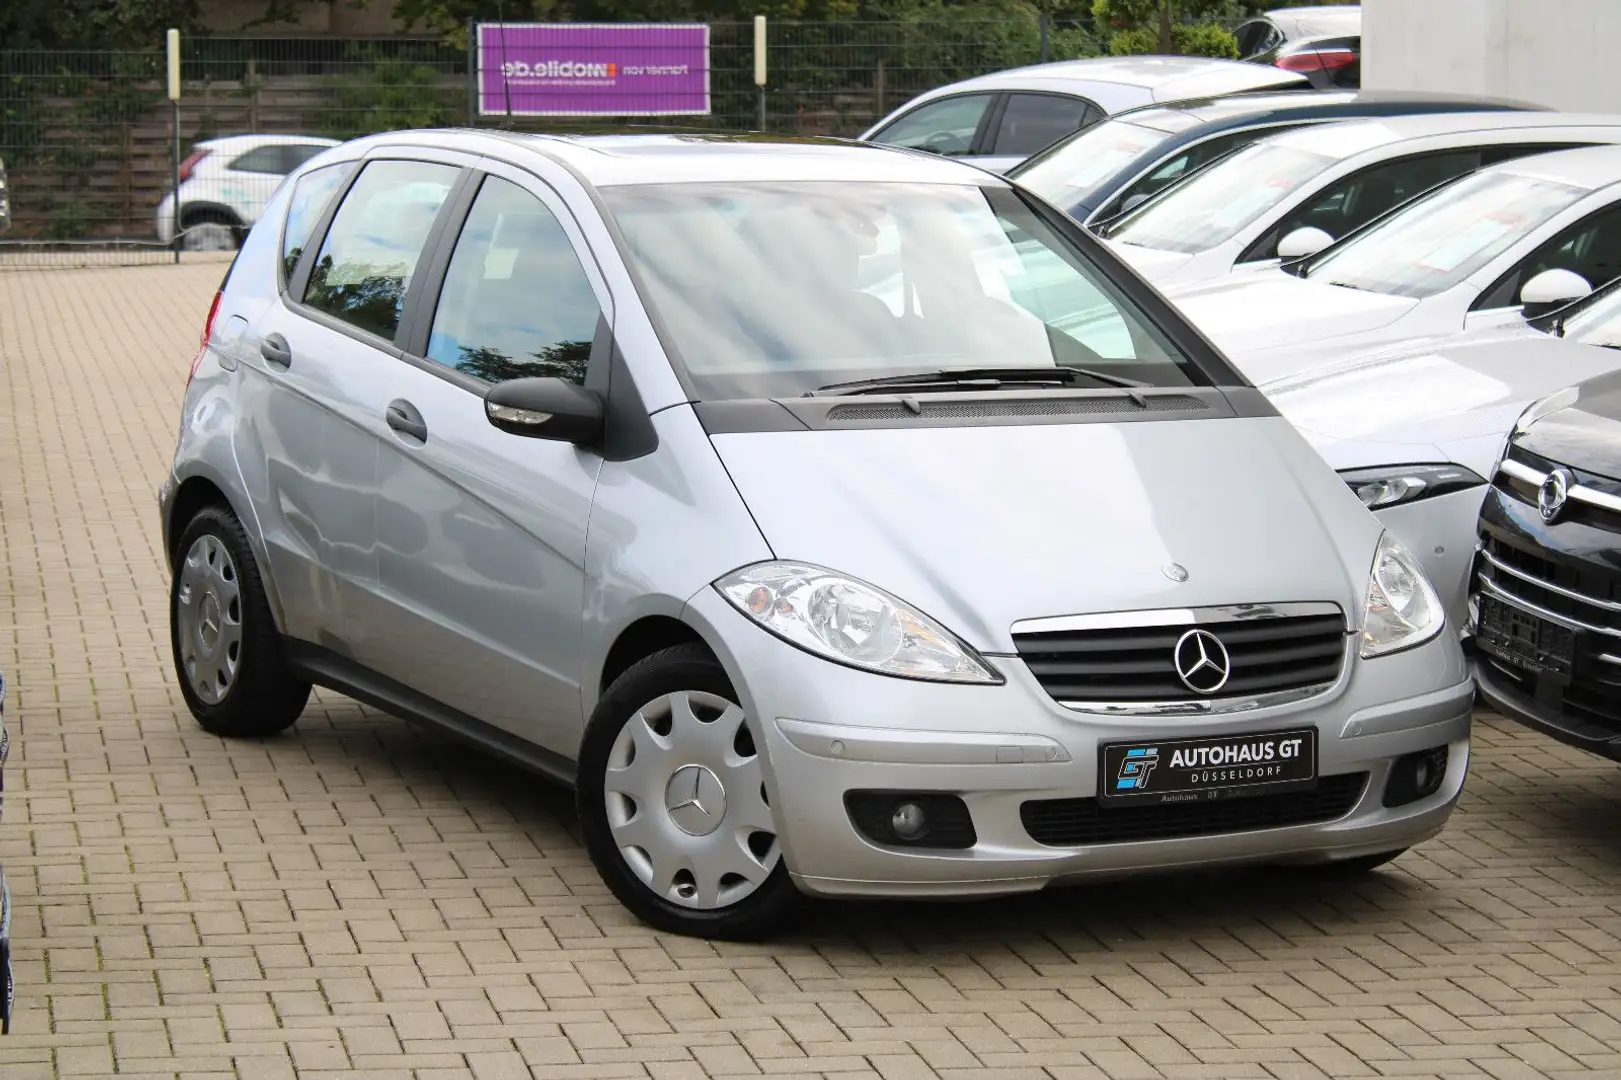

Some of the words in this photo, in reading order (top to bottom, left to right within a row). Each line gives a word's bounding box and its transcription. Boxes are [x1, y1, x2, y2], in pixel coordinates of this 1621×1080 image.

[1169, 741, 1275, 768] AUTOHAUS
[1278, 739, 1302, 757] GT
[1191, 766, 1282, 783] DÜSSELDORF
[1160, 793, 1198, 803] Autohaus
